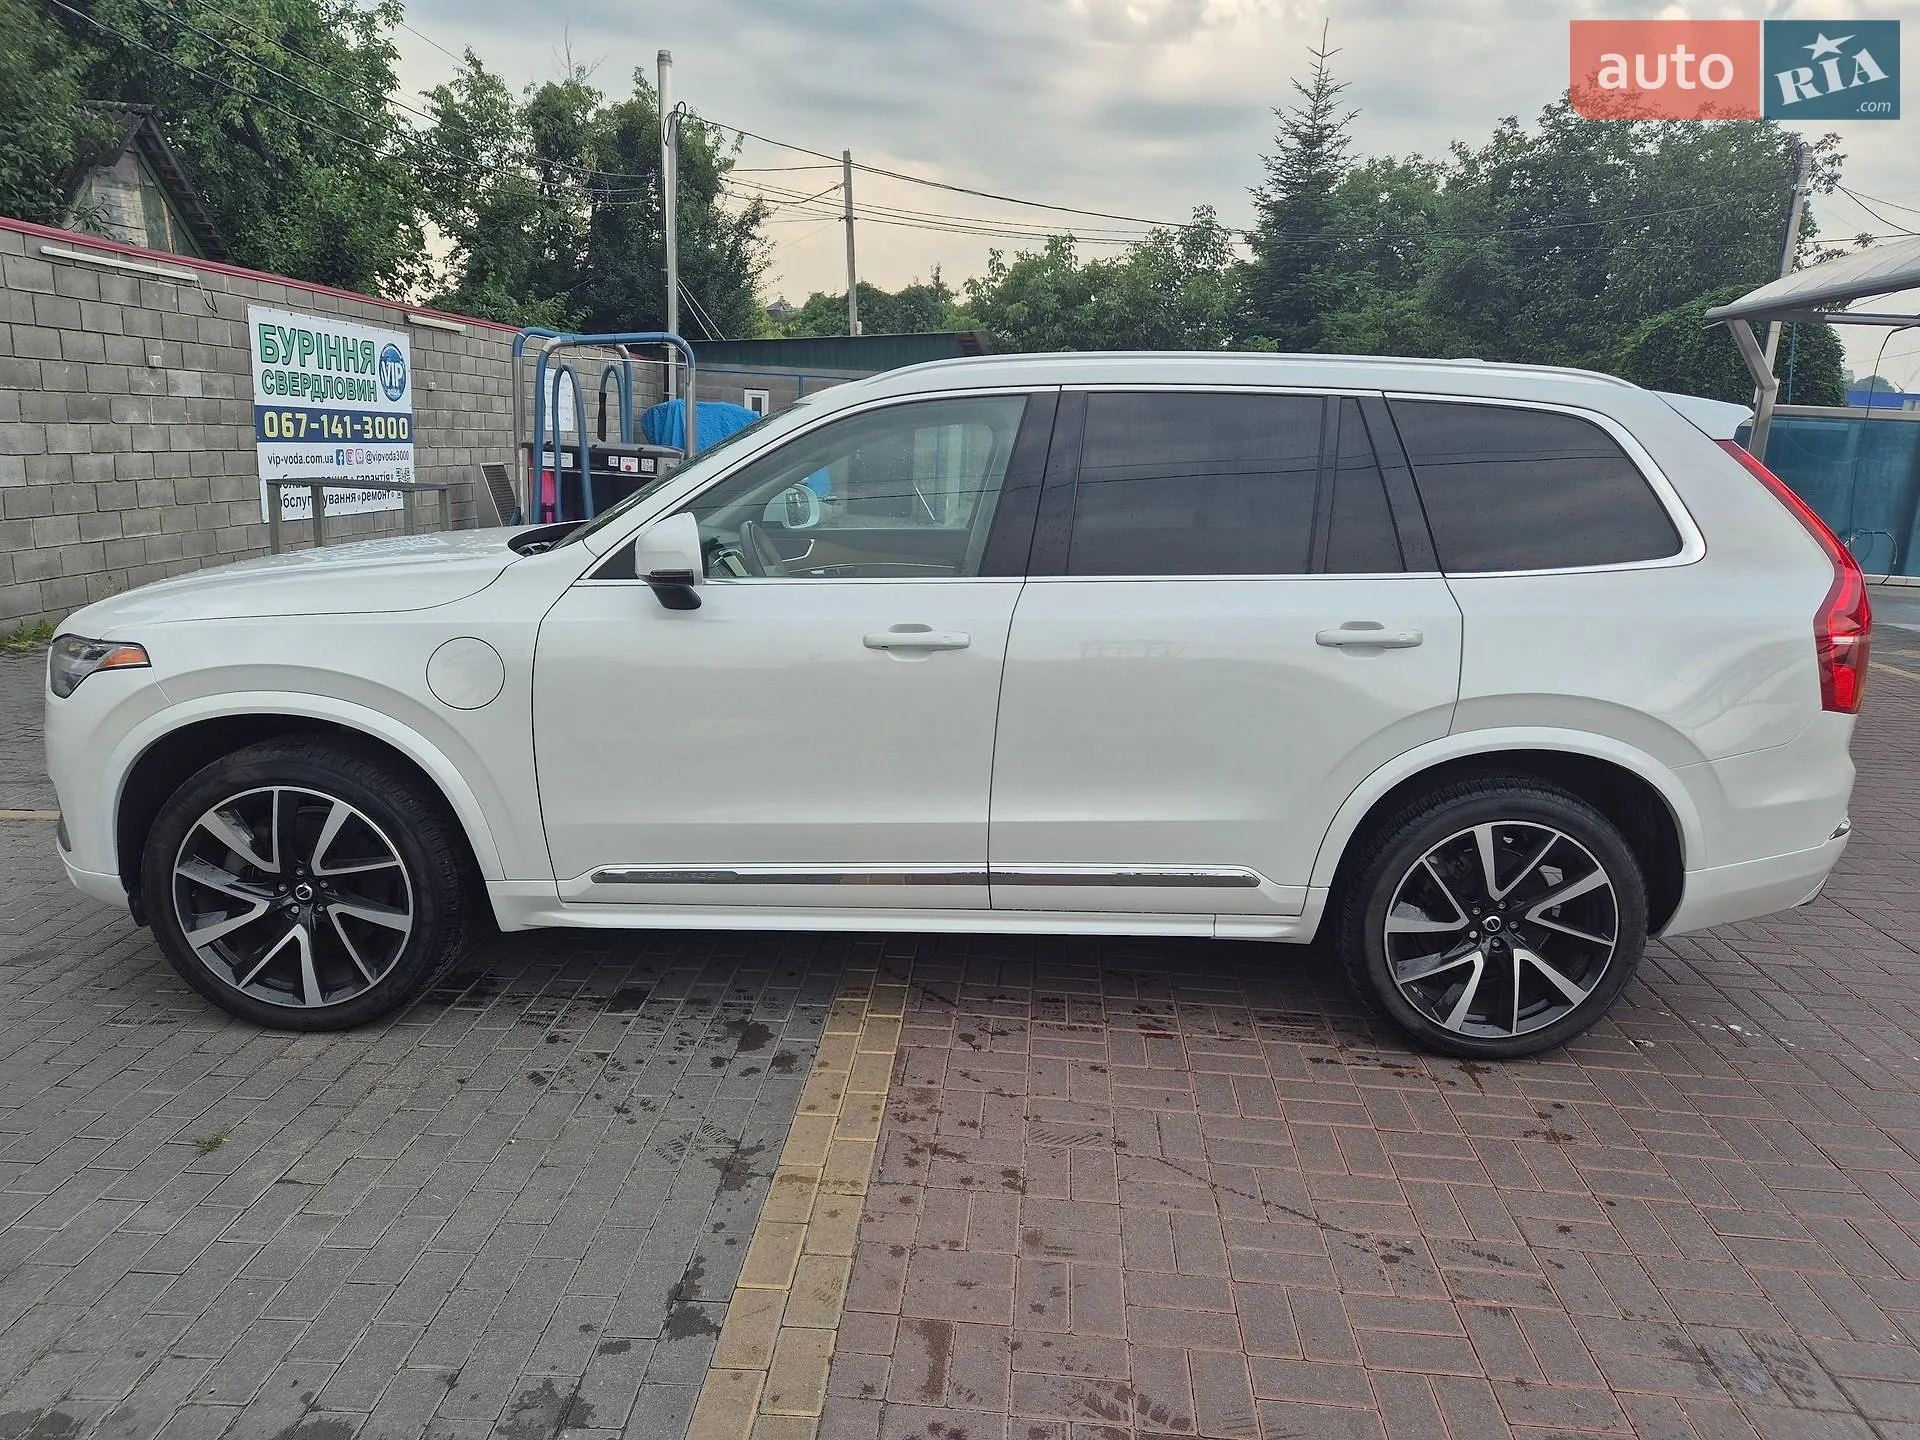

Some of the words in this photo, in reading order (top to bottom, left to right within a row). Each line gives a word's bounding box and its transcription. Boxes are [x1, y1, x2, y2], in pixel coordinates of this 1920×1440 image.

[258, 322, 376, 375] БУРІННЯ
[261, 368, 378, 402] СВЕРДЛОВИН
[380, 360, 404, 388] VIP
[263, 411, 409, 440] 067-141-3000
[266, 453, 333, 467] vip-voda.com.ua
[365, 450, 409, 465] @vipvoda3000
[361, 489, 391, 504] ремонт
